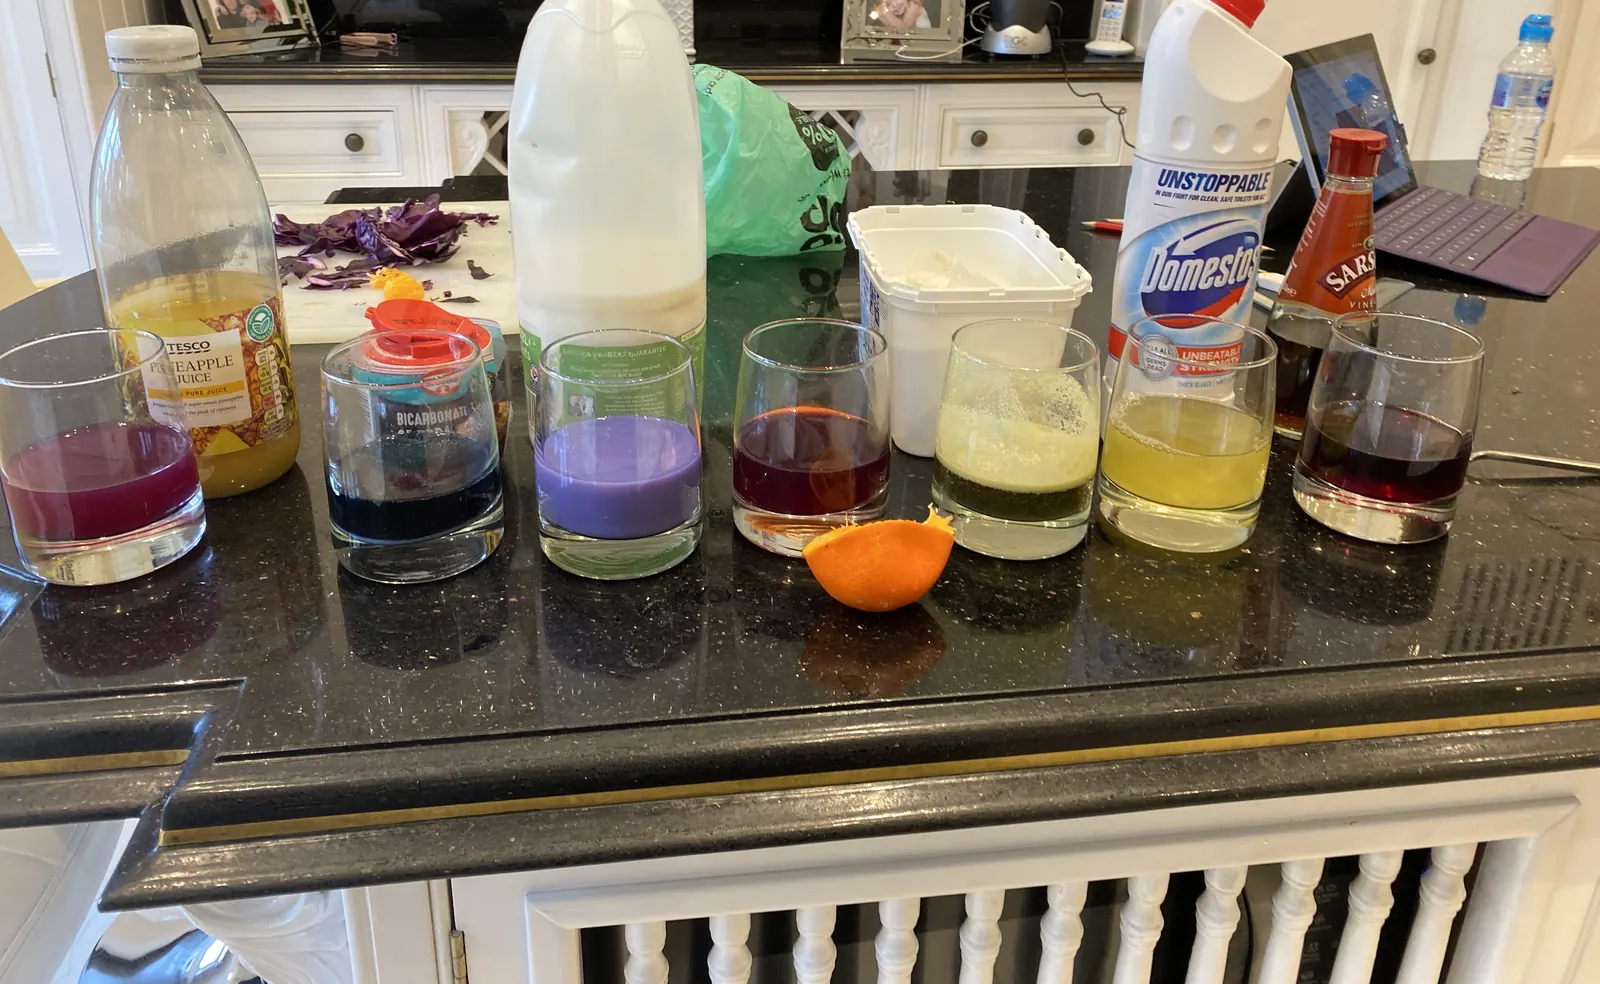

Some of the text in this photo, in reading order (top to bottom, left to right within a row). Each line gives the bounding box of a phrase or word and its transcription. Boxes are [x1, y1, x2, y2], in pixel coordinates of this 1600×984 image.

[1157, 168, 1271, 193] UNSTOPPABLE
[1172, 192, 1189, 200] FIGHT
[1199, 195, 1219, 203] CLEAN,
[1219, 195, 1234, 203] SAFE
[1141, 243, 1263, 293] Domestos
[166, 341, 211, 352] TESCO
[1146, 357, 1167, 367] GERMS
[1147, 363, 1164, 372] DEAD
[176, 372, 212, 384] JUICE
[206, 386, 228, 395] JUICE
